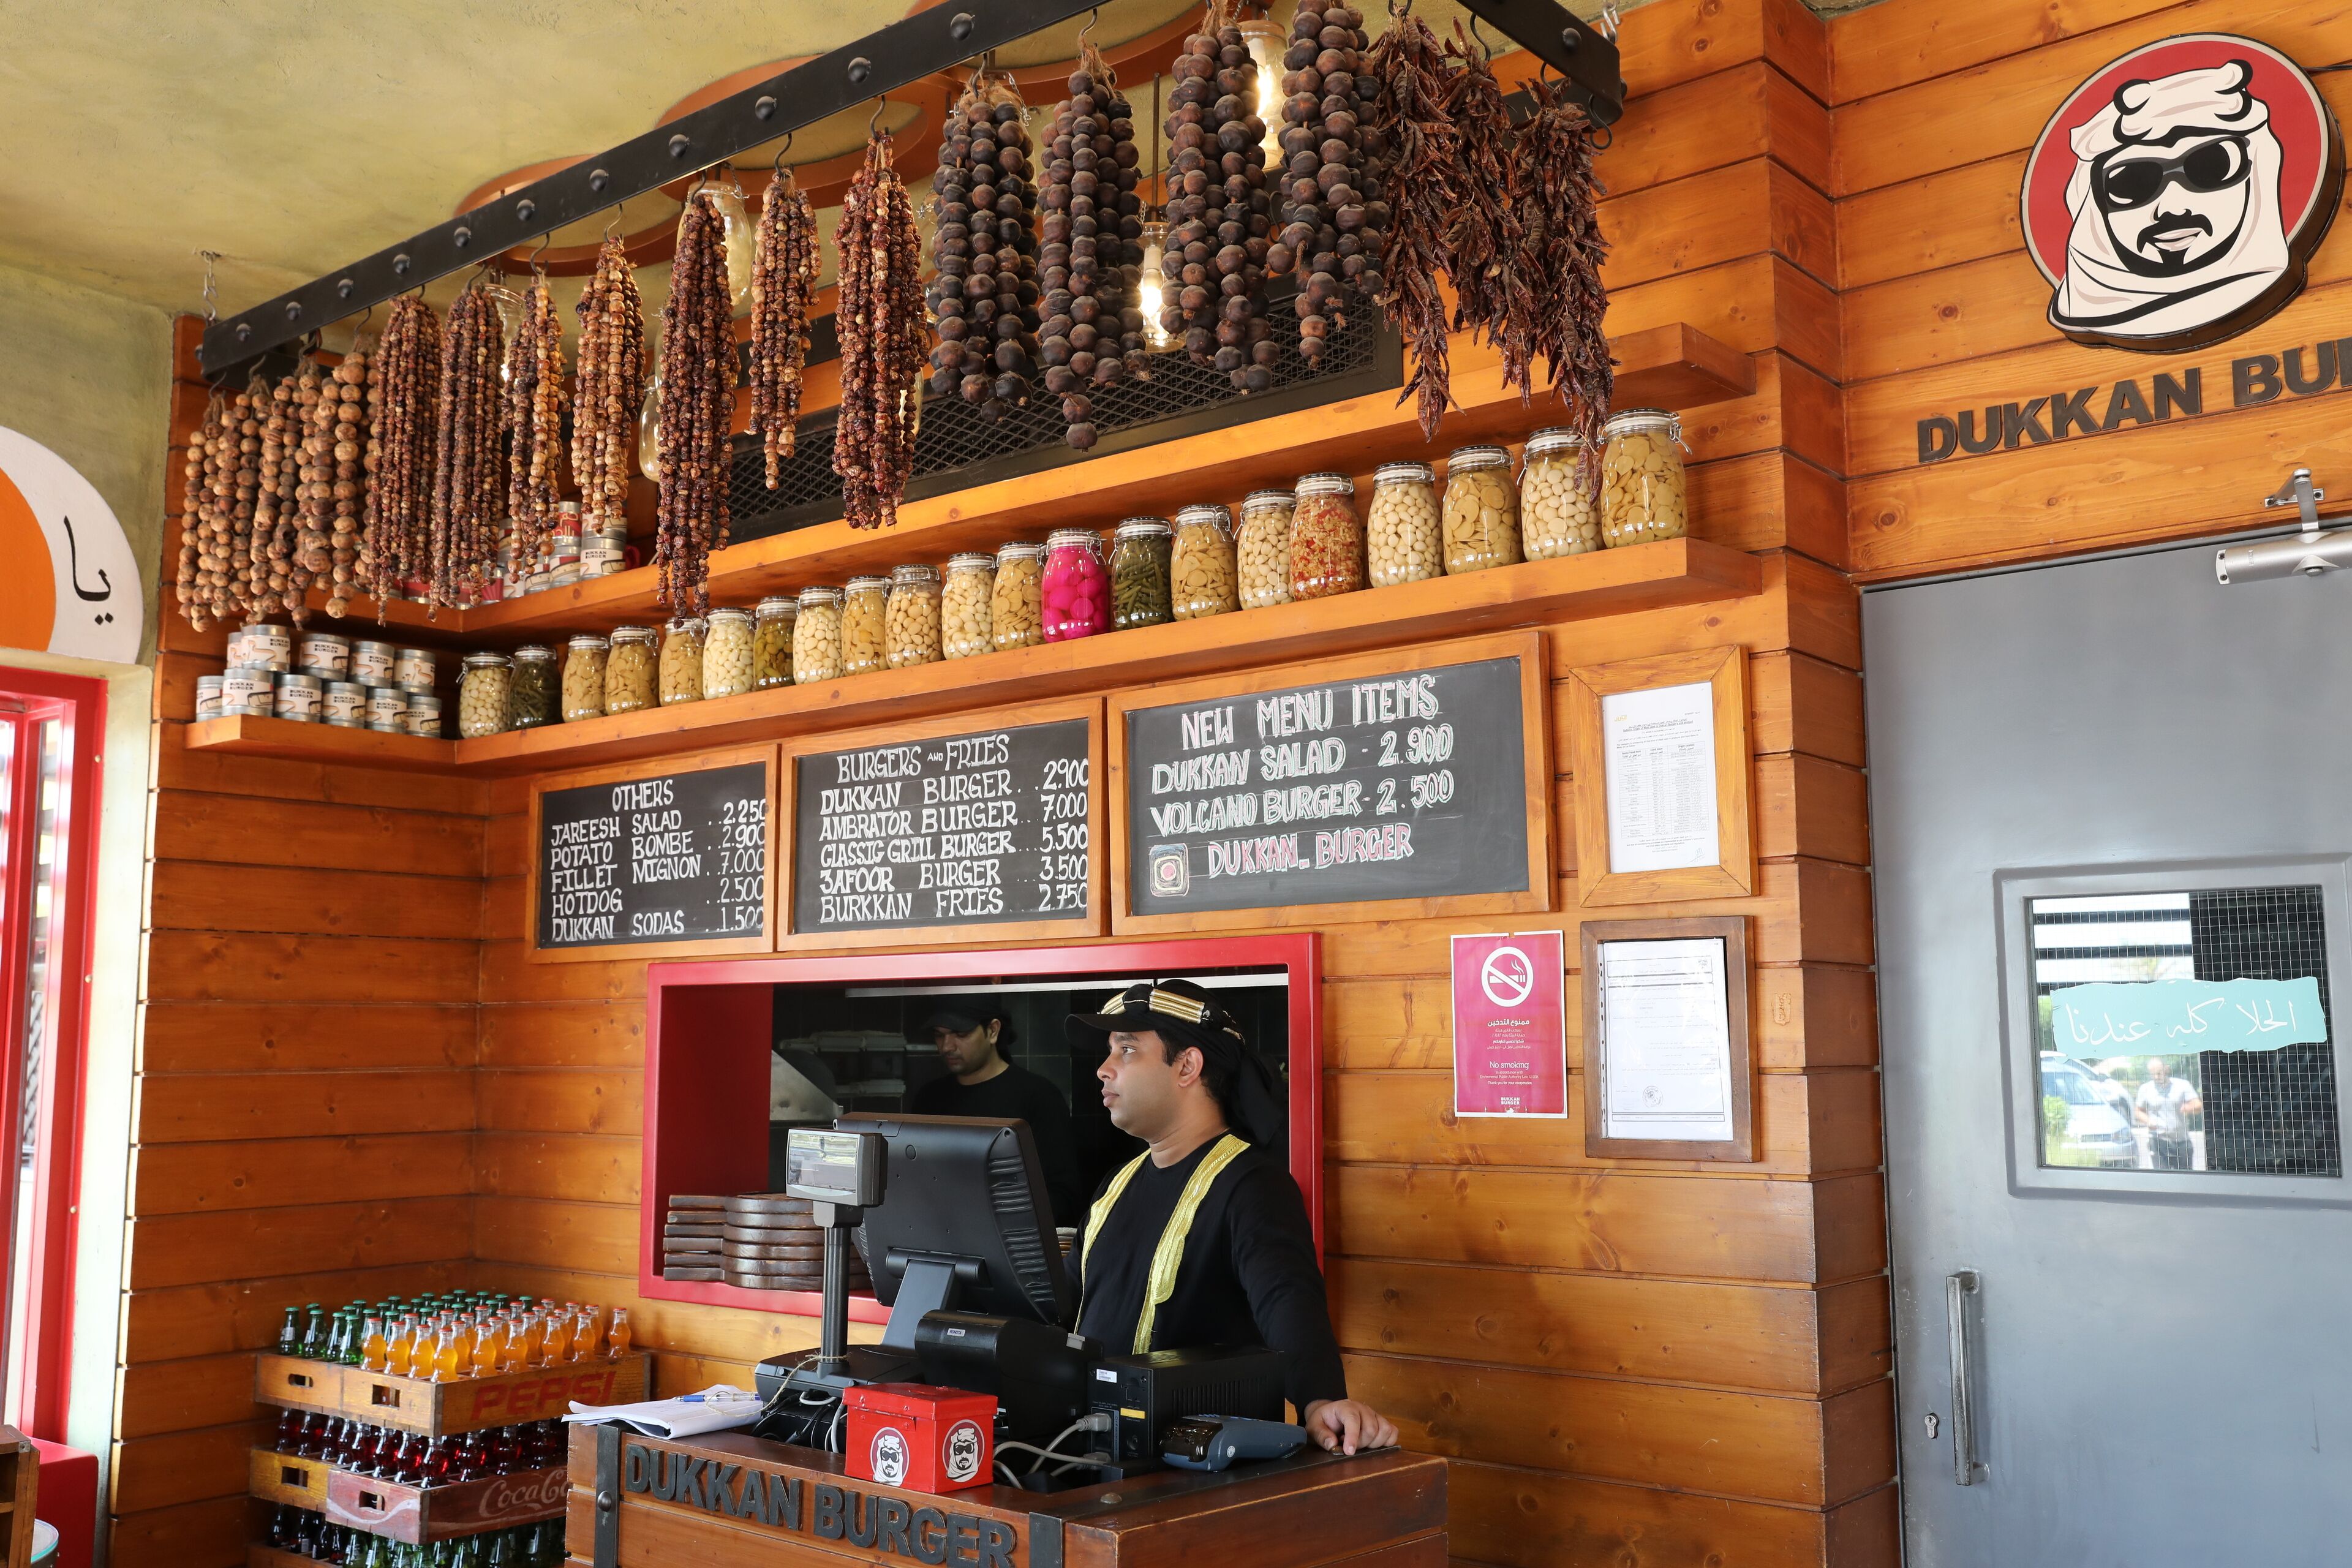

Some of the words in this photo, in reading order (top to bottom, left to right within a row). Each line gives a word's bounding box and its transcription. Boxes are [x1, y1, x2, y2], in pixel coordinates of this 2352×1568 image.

[1917, 368, 2203, 464] DUKKAN
[2231, 337, 2352, 407] BU
[1182, 706, 1234, 750] NEW
[1257, 689, 1333, 738] MENU
[1352, 674, 1439, 727] ITEMS
[837, 746, 921, 783] BURGERS
[927, 752, 943, 762] AND
[945, 734, 1009, 771] FRIES
[1152, 748, 1251, 794] DUKKAN
[1260, 737, 1346, 781] SALAD
[612, 779, 674, 812] OTHERS
[820, 781, 902, 815] DUKKAN
[923, 769, 1012, 804] BURGER
[1150, 793, 1257, 837] VOLCANO
[1264, 780, 1363, 824] BURGER
[551, 816, 621, 846] JAREESH
[631, 810, 682, 835] SALAD
[819, 810, 914, 841] AMBRATOR
[921, 801, 1018, 835] BURGER
[1041, 792, 1088, 823] 7.000
[551, 841, 613, 870] POTATO
[631, 831, 693, 860] BOMBE
[888, 837, 936, 863] GRILL
[940, 831, 1017, 859] BURGER
[1039, 822, 1088, 853] 5.500
[551, 864, 618, 892] FILLET
[632, 854, 701, 884] MIGNON
[820, 866, 895, 894] 3AFOOR
[919, 859, 1001, 889] BURGER
[1039, 853, 1088, 881] 3.500
[552, 888, 623, 918] HOTDOG
[820, 892, 912, 924] BURKKAN
[936, 888, 1004, 918] FRIES
[551, 915, 614, 942] DUKKAN
[631, 910, 685, 936] SODAS
[2065, 1003, 2152, 1046] عندنا
[2166, 997, 2225, 1038] كله
[2236, 999, 2296, 1035] الحلا
[1501, 1061, 1529, 1070] smoking
[470, 1371, 616, 1421] PEPSI
[625, 1444, 803, 1531] DUKKAN
[813, 1483, 1018, 1568] BURGER
